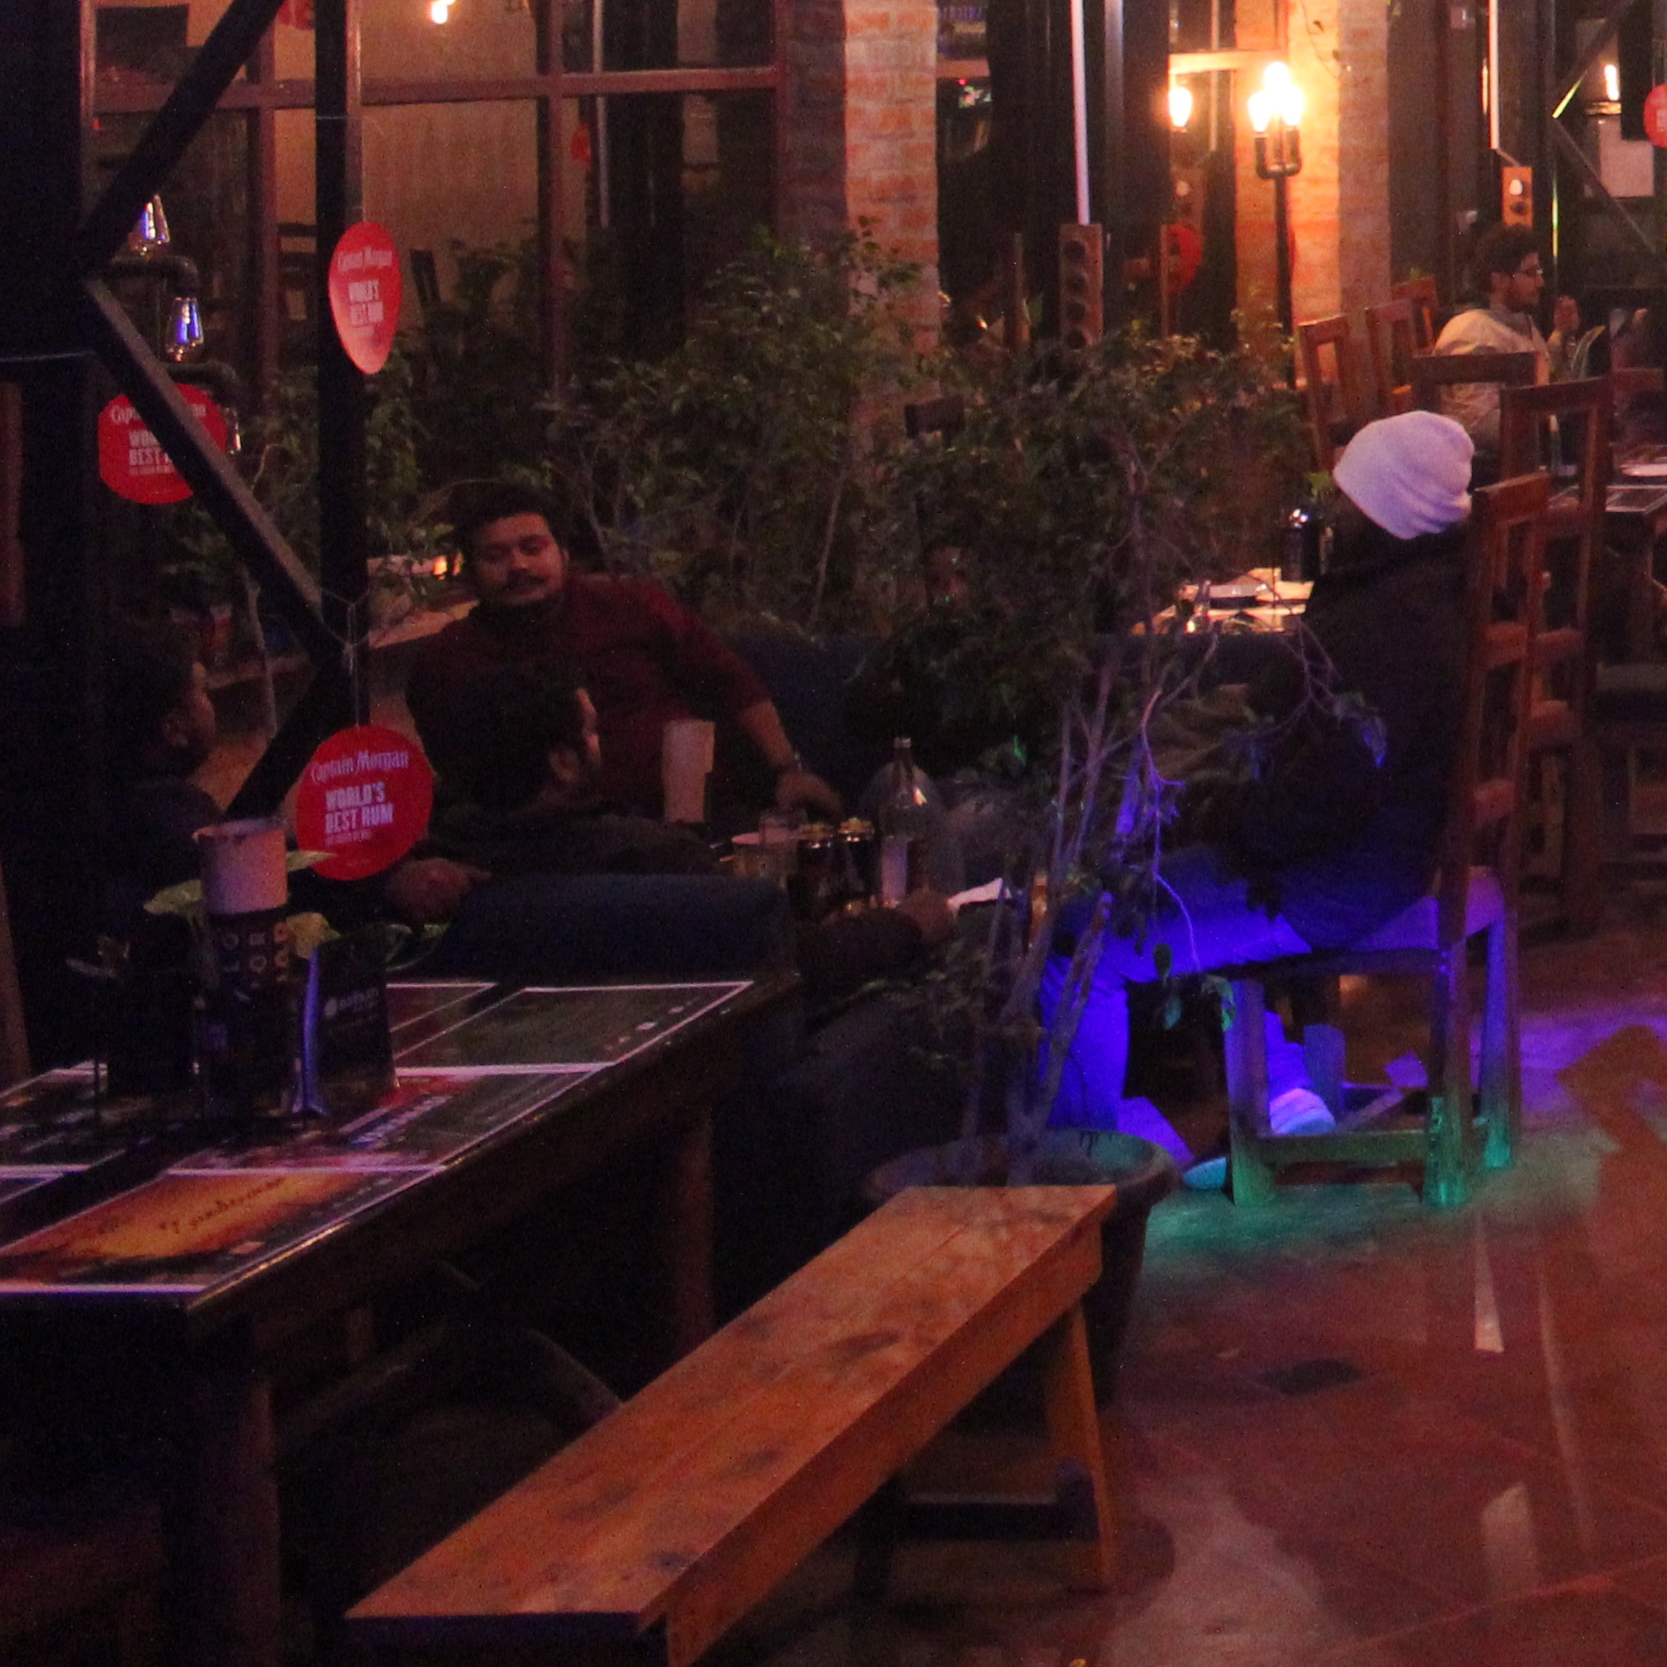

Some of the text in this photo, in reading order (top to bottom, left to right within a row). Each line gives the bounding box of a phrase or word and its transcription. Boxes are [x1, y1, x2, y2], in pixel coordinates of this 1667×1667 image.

[355, 749, 410, 774] Morgan
[325, 781, 386, 811] WORLD'S
[325, 803, 394, 834] BEST RUM
